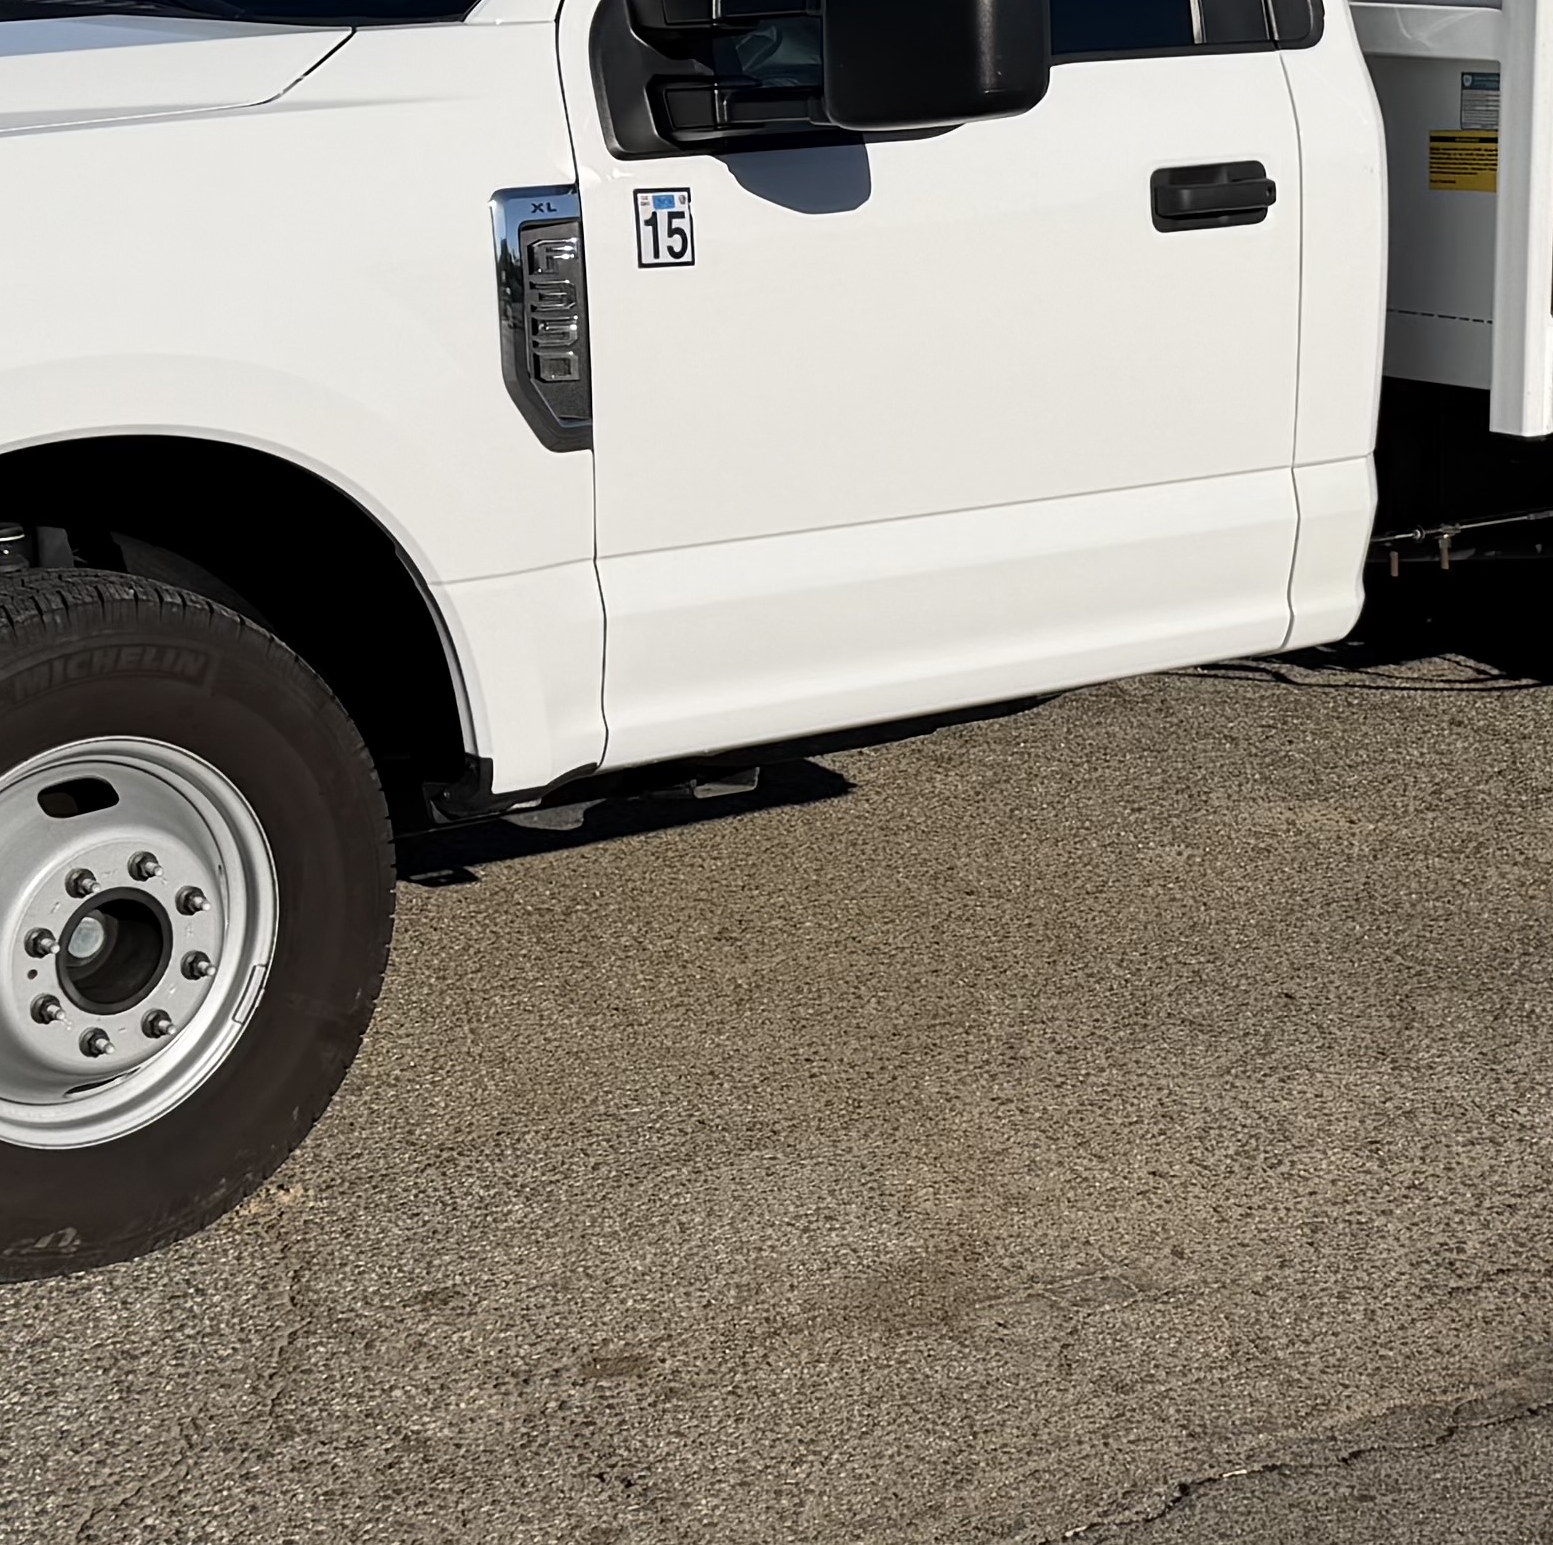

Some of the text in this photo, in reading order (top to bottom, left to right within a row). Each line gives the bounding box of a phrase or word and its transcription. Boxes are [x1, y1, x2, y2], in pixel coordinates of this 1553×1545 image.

[531, 202, 557, 213] XL
[644, 211, 688, 260] 15
[14, 644, 208, 701] MICHELIN
